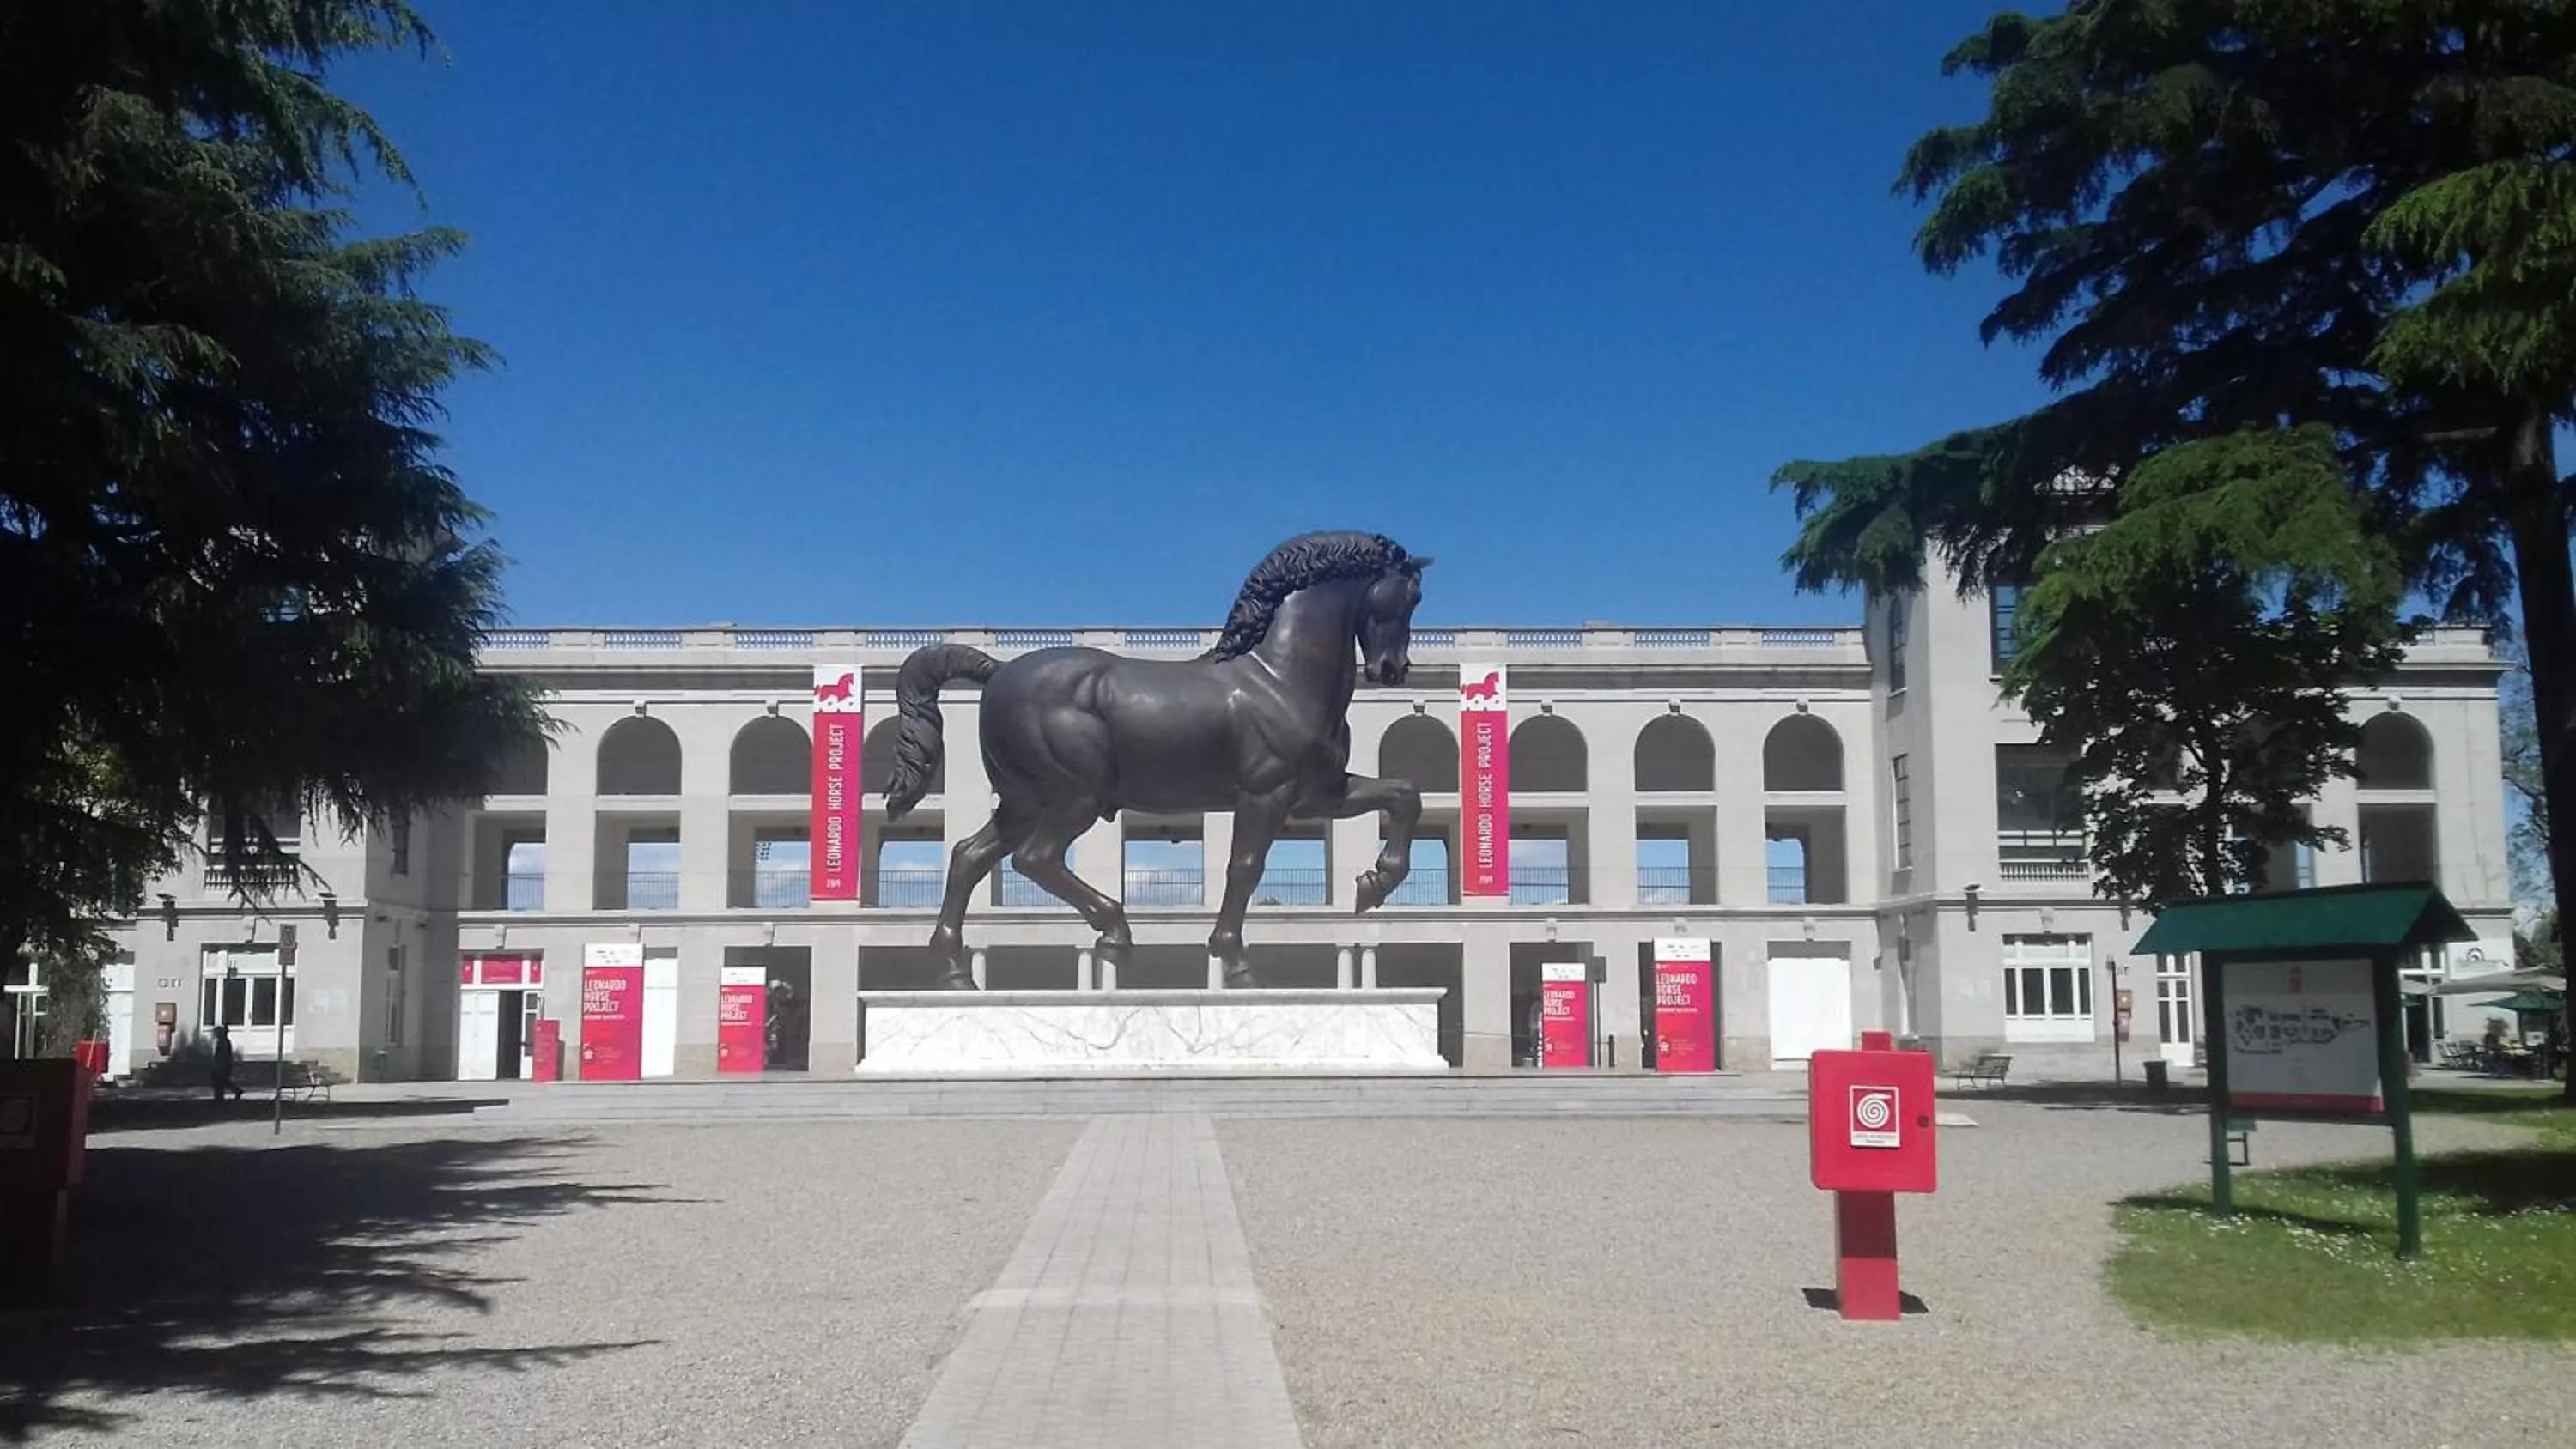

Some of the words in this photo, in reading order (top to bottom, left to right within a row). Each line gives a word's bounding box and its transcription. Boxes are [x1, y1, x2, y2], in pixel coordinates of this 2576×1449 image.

[829, 724, 846, 770] PROJECT
[1477, 722, 1492, 768] PROJECT
[828, 776, 844, 810] HORSE
[1478, 773, 1492, 808] HORSE
[826, 816, 842, 871] LEONARDO
[1478, 813, 1493, 868] LEONARDO
[584, 979, 627, 991] LEONARDO
[1656, 973, 1698, 985] LEONARDO
[1656, 984, 1681, 995] HORSE
[584, 991, 611, 1002] HORSE
[584, 1000, 620, 1013] PROJECT
[1656, 994, 1691, 1006] PROJECT
